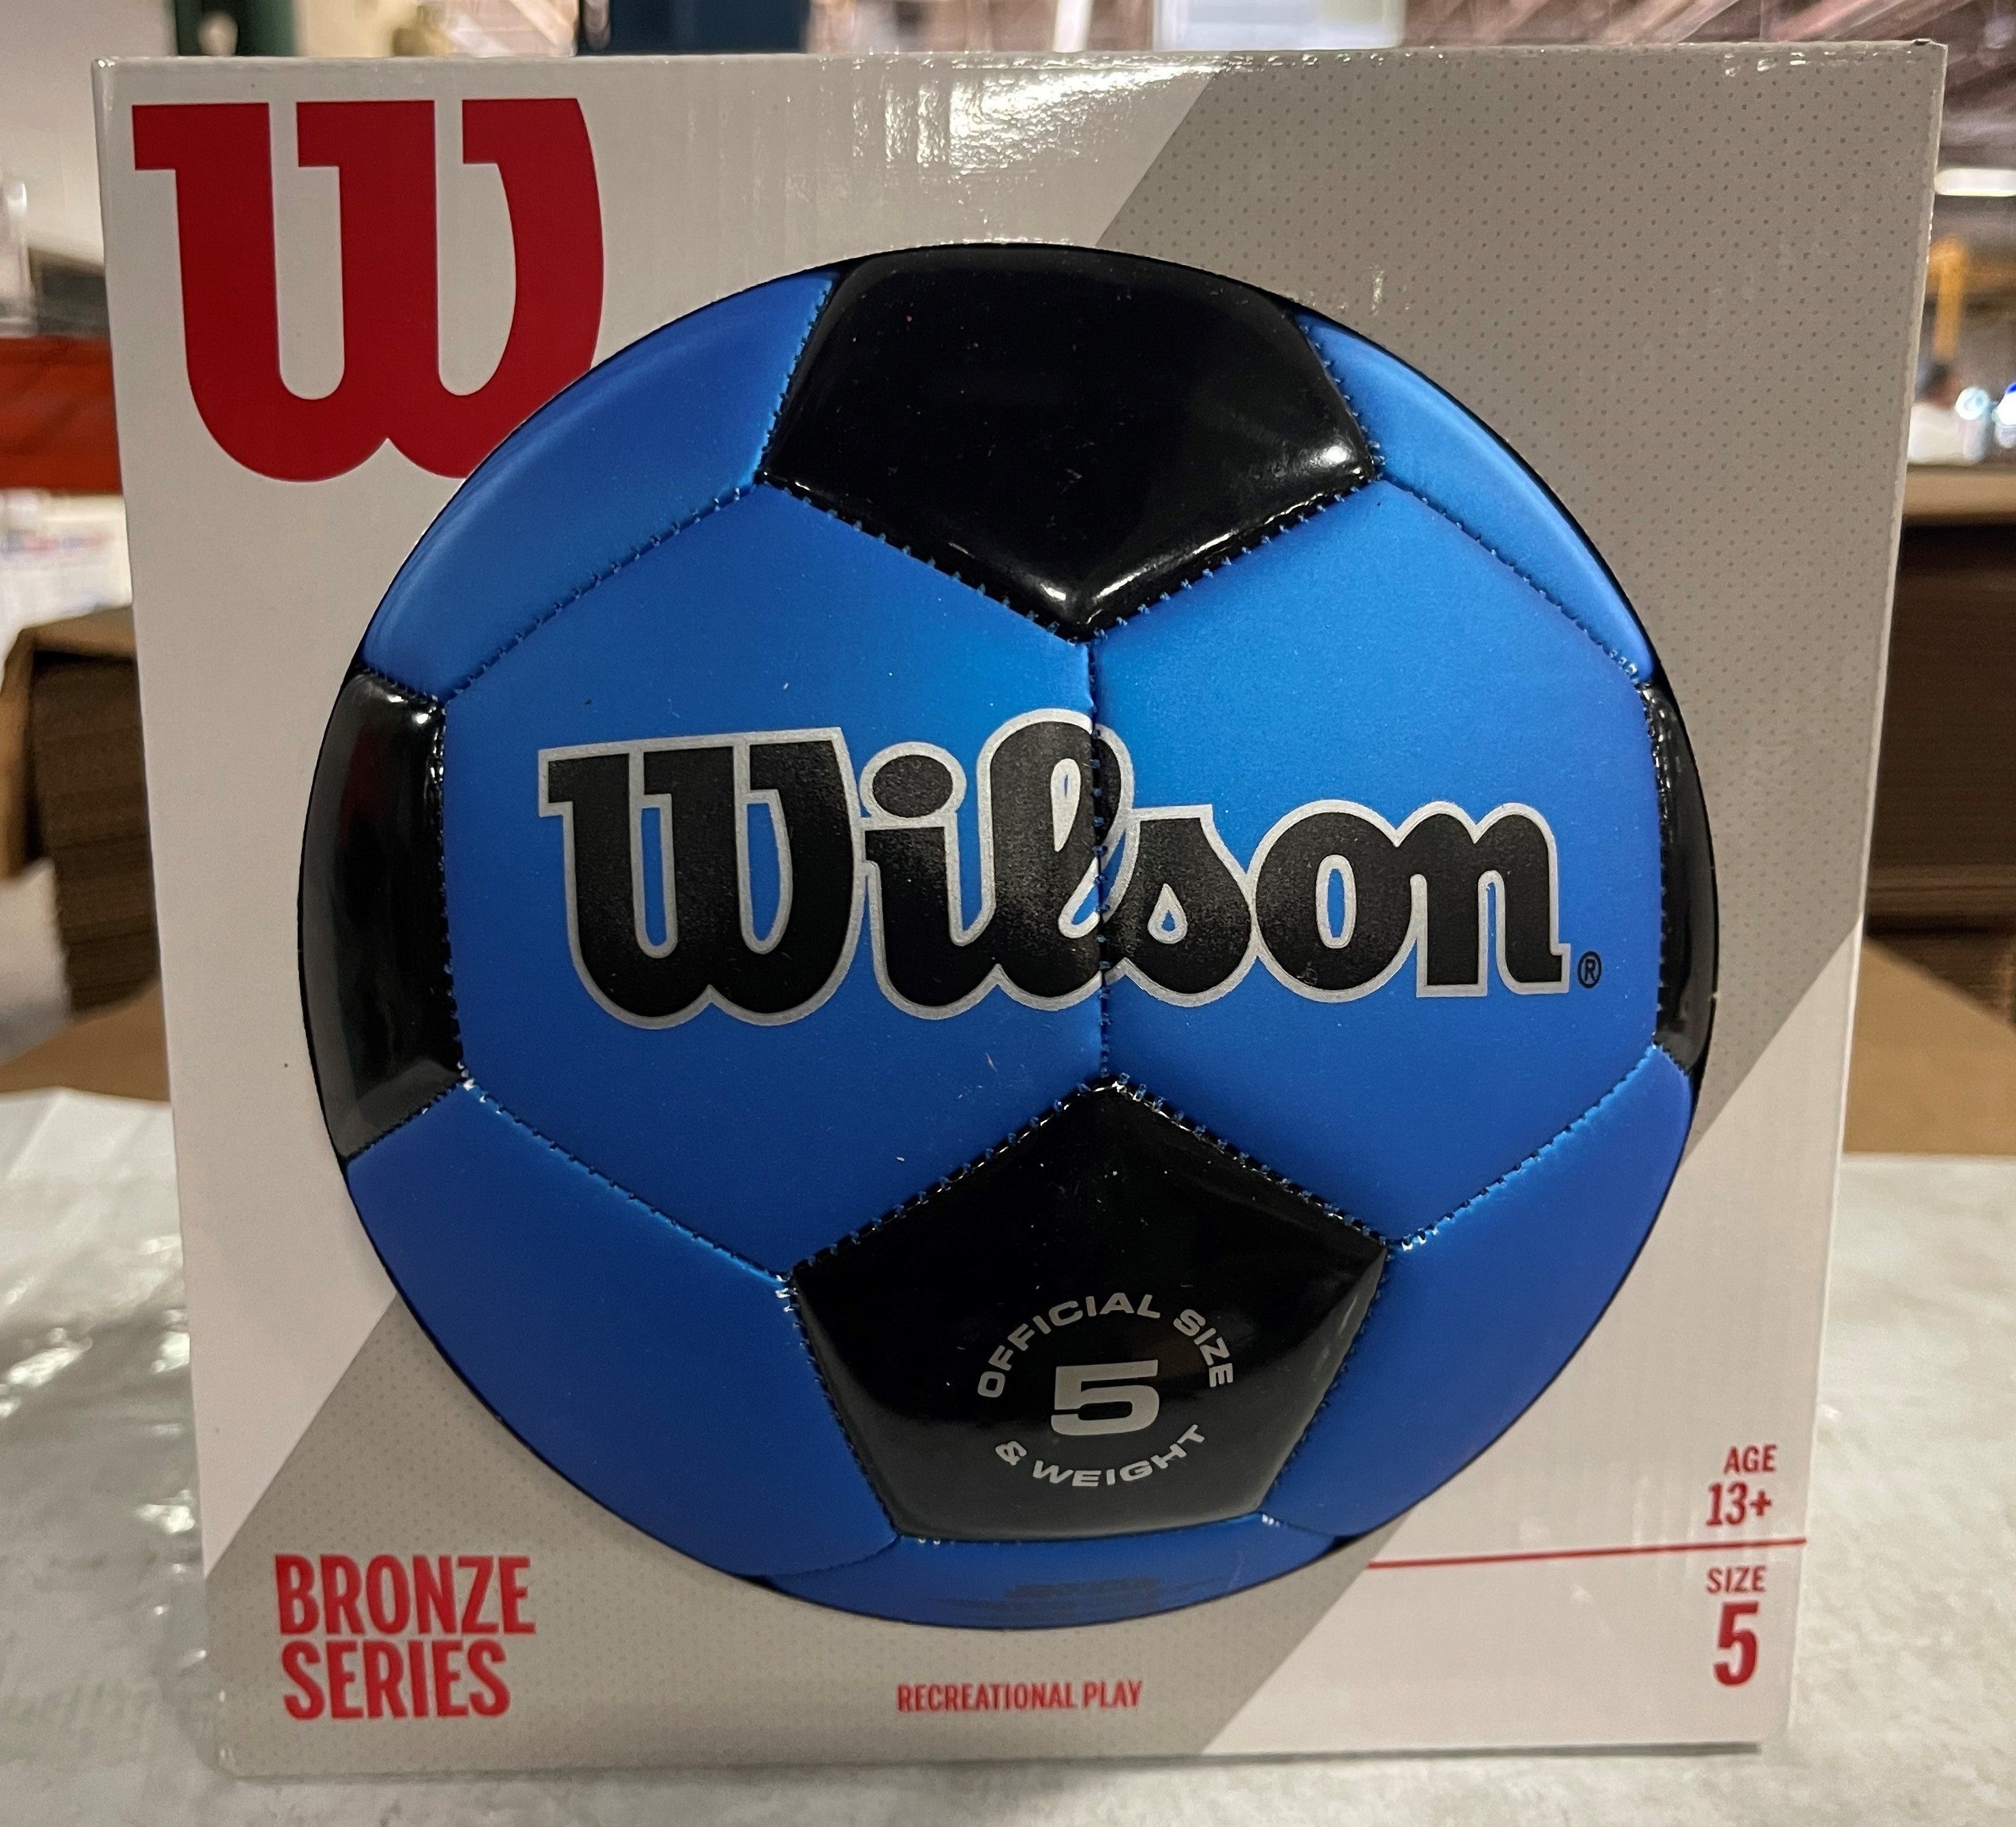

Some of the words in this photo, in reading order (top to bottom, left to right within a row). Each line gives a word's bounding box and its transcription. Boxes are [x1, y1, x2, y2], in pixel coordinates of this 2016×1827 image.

[132, 98, 603, 482] W
[977, 1293, 1161, 1398] OFFICIAL
[1173, 1309, 1234, 1387] SIZE
[1051, 1360, 1159, 1436] 5
[995, 1441, 1027, 1466] &
[1032, 1424, 1205, 1487] WEIGHT
[1724, 1444, 1777, 1473] AGE
[1706, 1481, 1773, 1526] 13+
[275, 1554, 536, 1636] BRONZE
[1706, 1565, 1767, 1593] SIZE
[281, 1640, 512, 1721] SERIES
[1713, 1601, 1759, 1687] 5
[896, 1681, 1078, 1713] RECREATIONAL
[1082, 1679, 1143, 1709] PLAY
